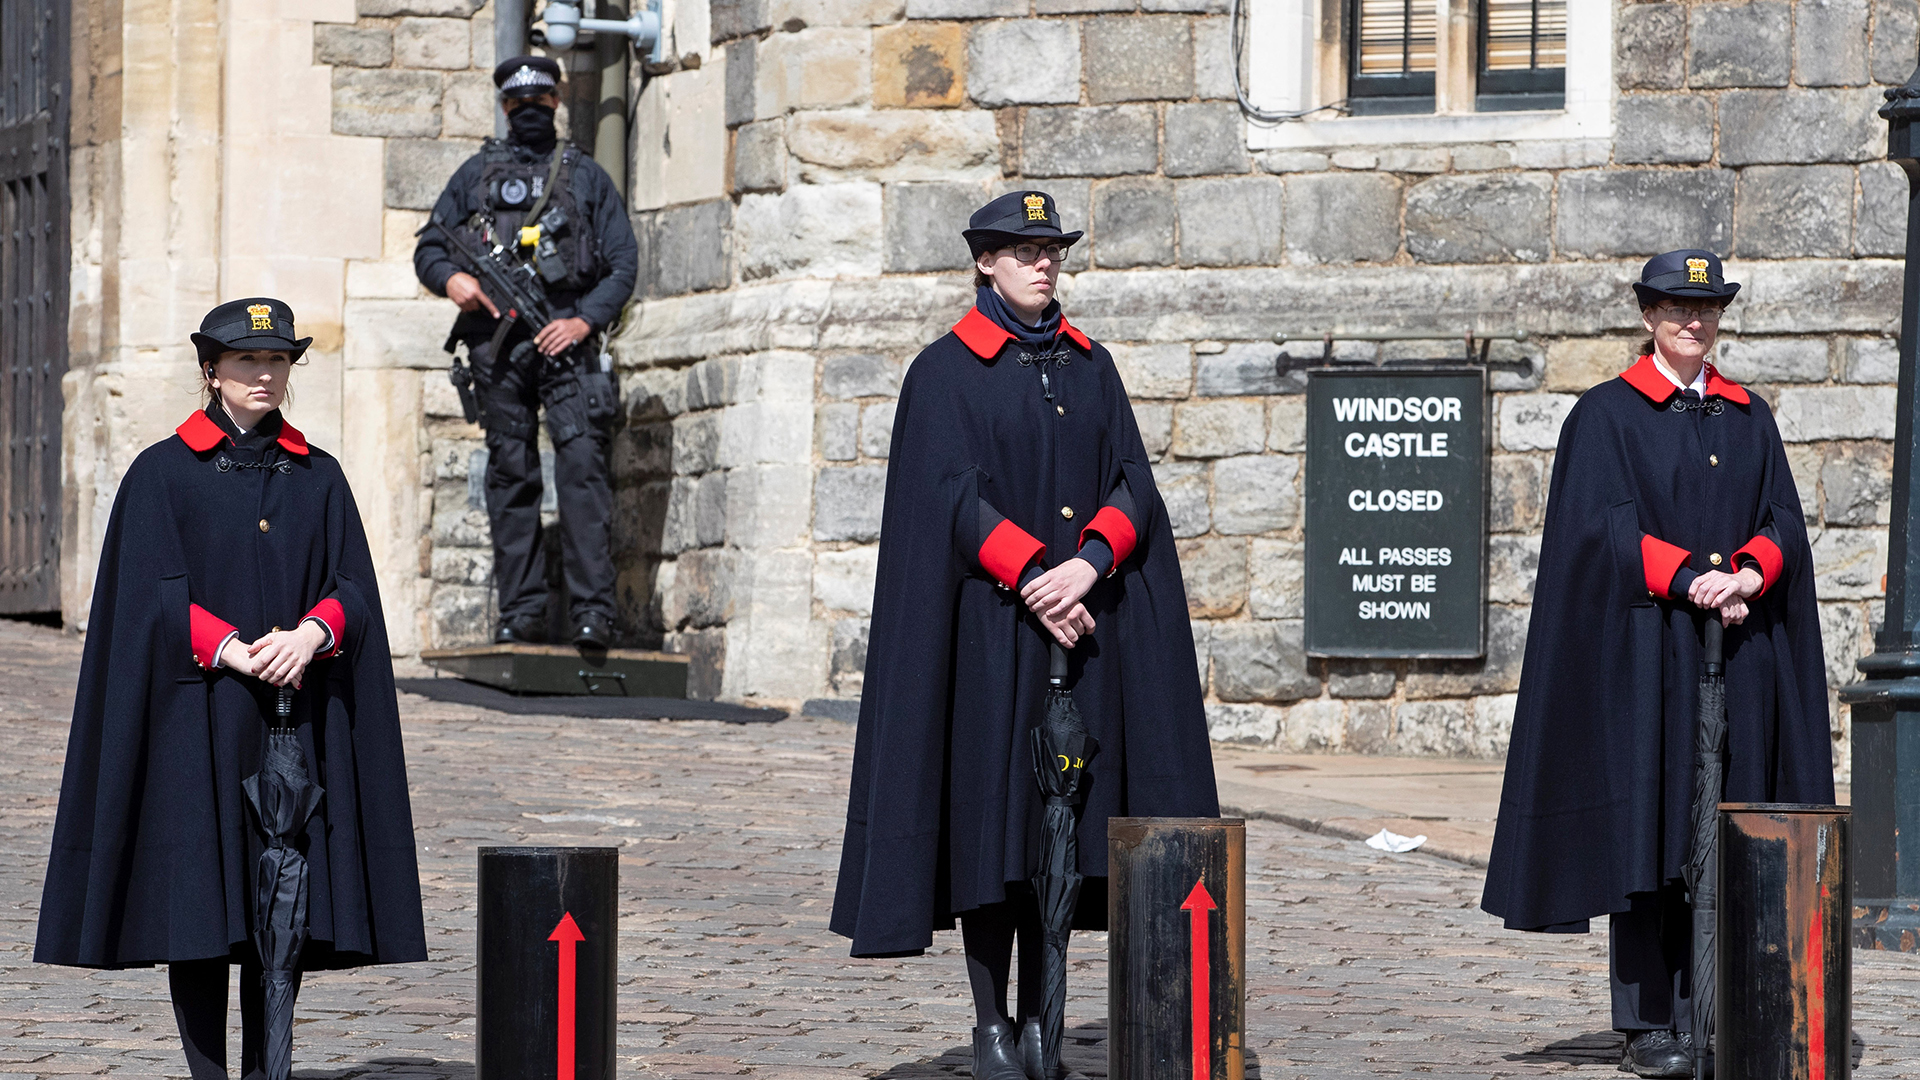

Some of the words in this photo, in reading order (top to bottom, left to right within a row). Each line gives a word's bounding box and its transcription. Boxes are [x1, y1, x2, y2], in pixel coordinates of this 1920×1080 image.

[1333, 397, 1462, 422] WINDSOR
[1345, 432, 1449, 457] CASTLE
[1348, 490, 1443, 511] CLOSED
[1338, 548, 1373, 566] ALL
[1379, 547, 1452, 566] PASSES
[1352, 574, 1405, 593] MUST
[1410, 574, 1436, 593] BE
[1358, 601, 1430, 620] SHOWN
